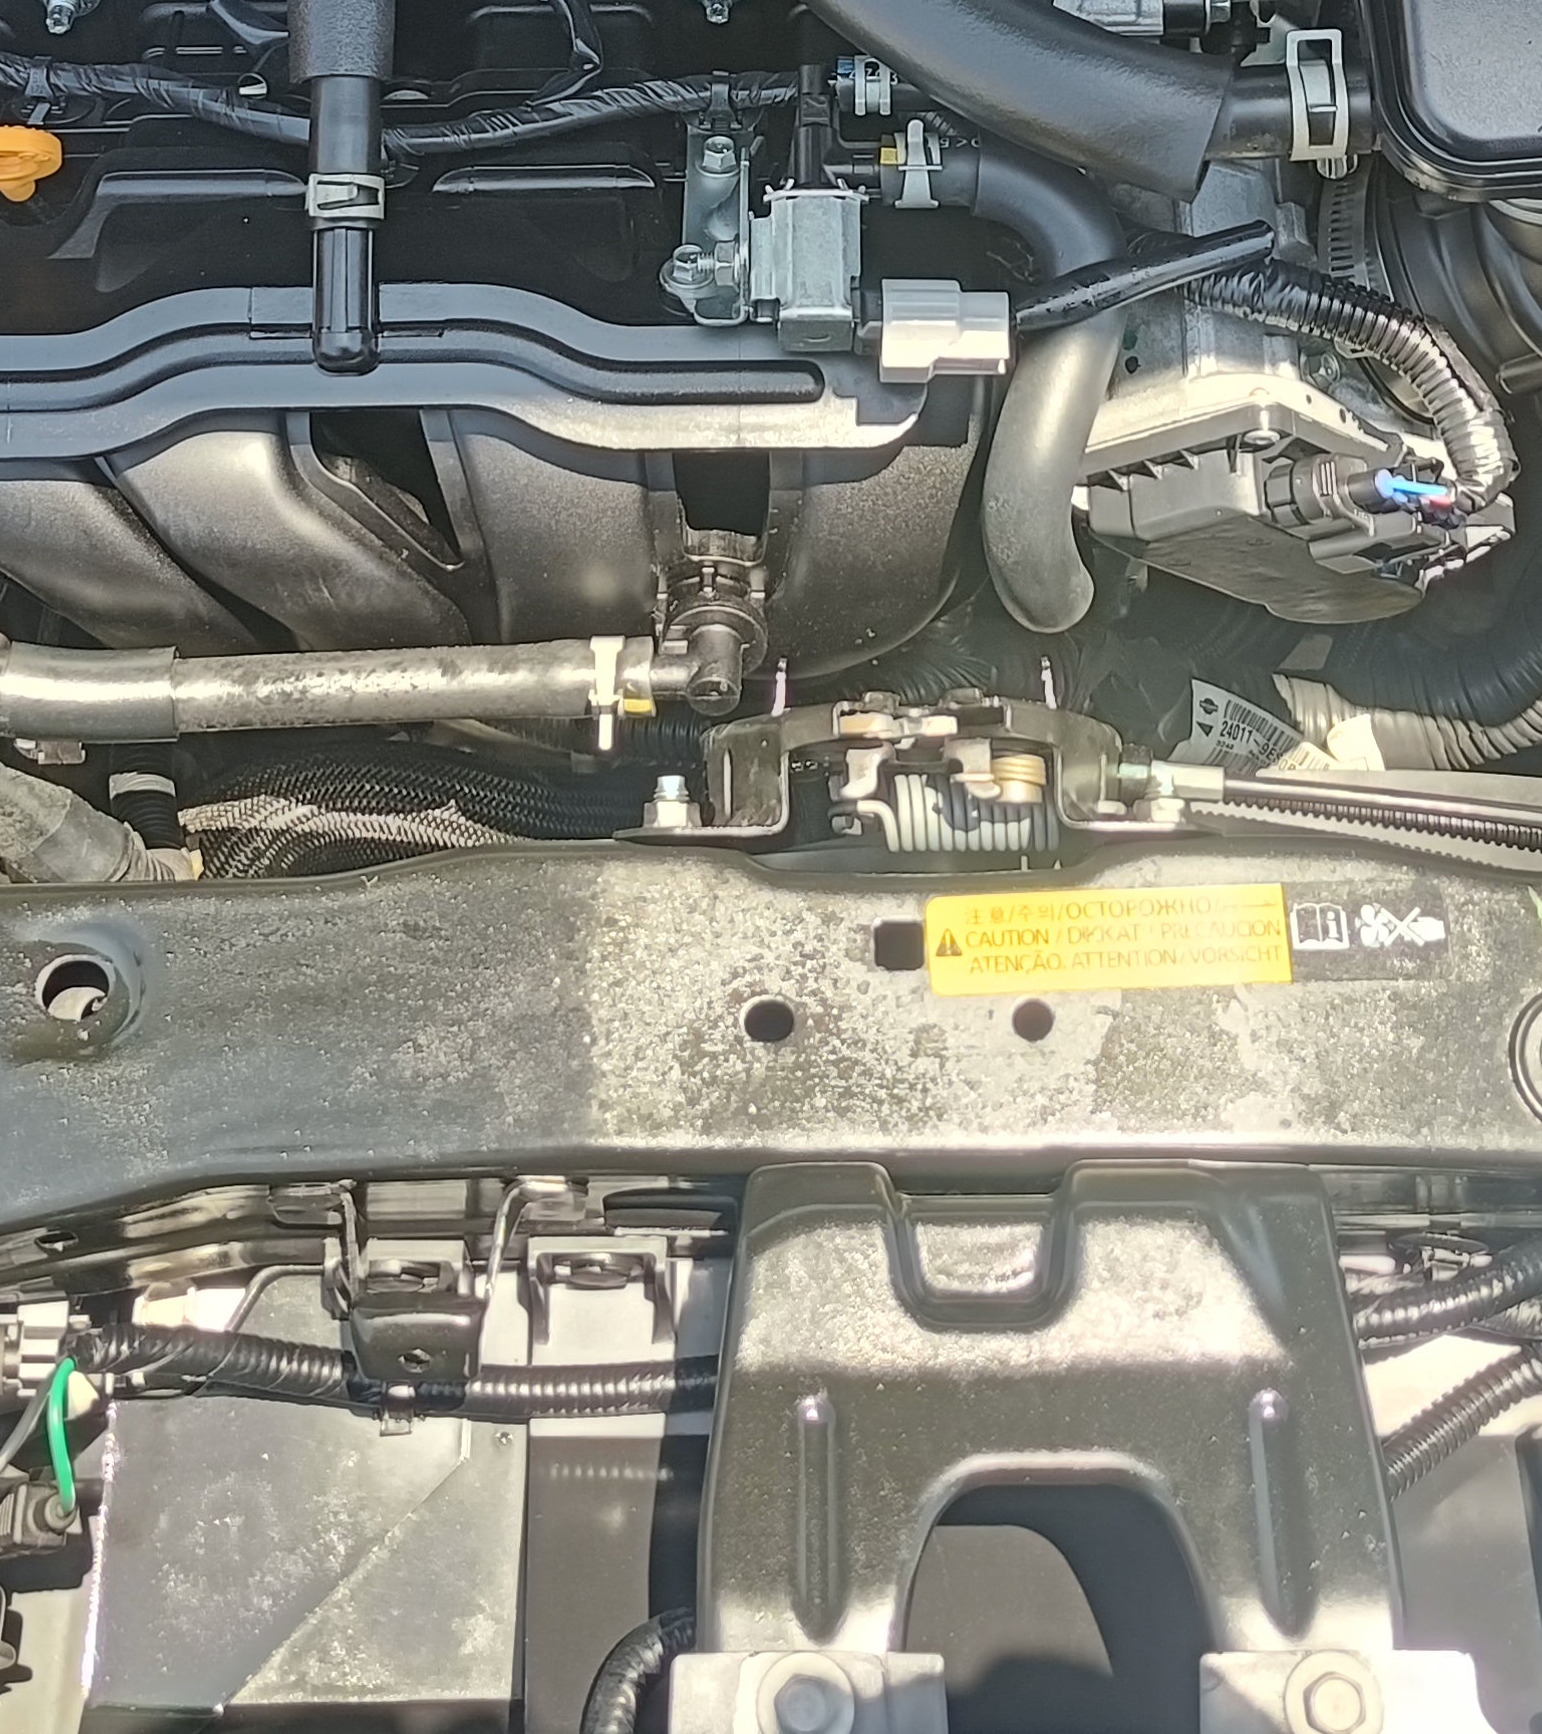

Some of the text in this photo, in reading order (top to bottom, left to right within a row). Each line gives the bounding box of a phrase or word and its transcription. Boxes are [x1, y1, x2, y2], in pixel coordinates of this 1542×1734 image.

[965, 929, 1049, 948] CAUTION
[1071, 948, 1177, 969] ATTENTION
[1187, 944, 1282, 964] VORSICHT
